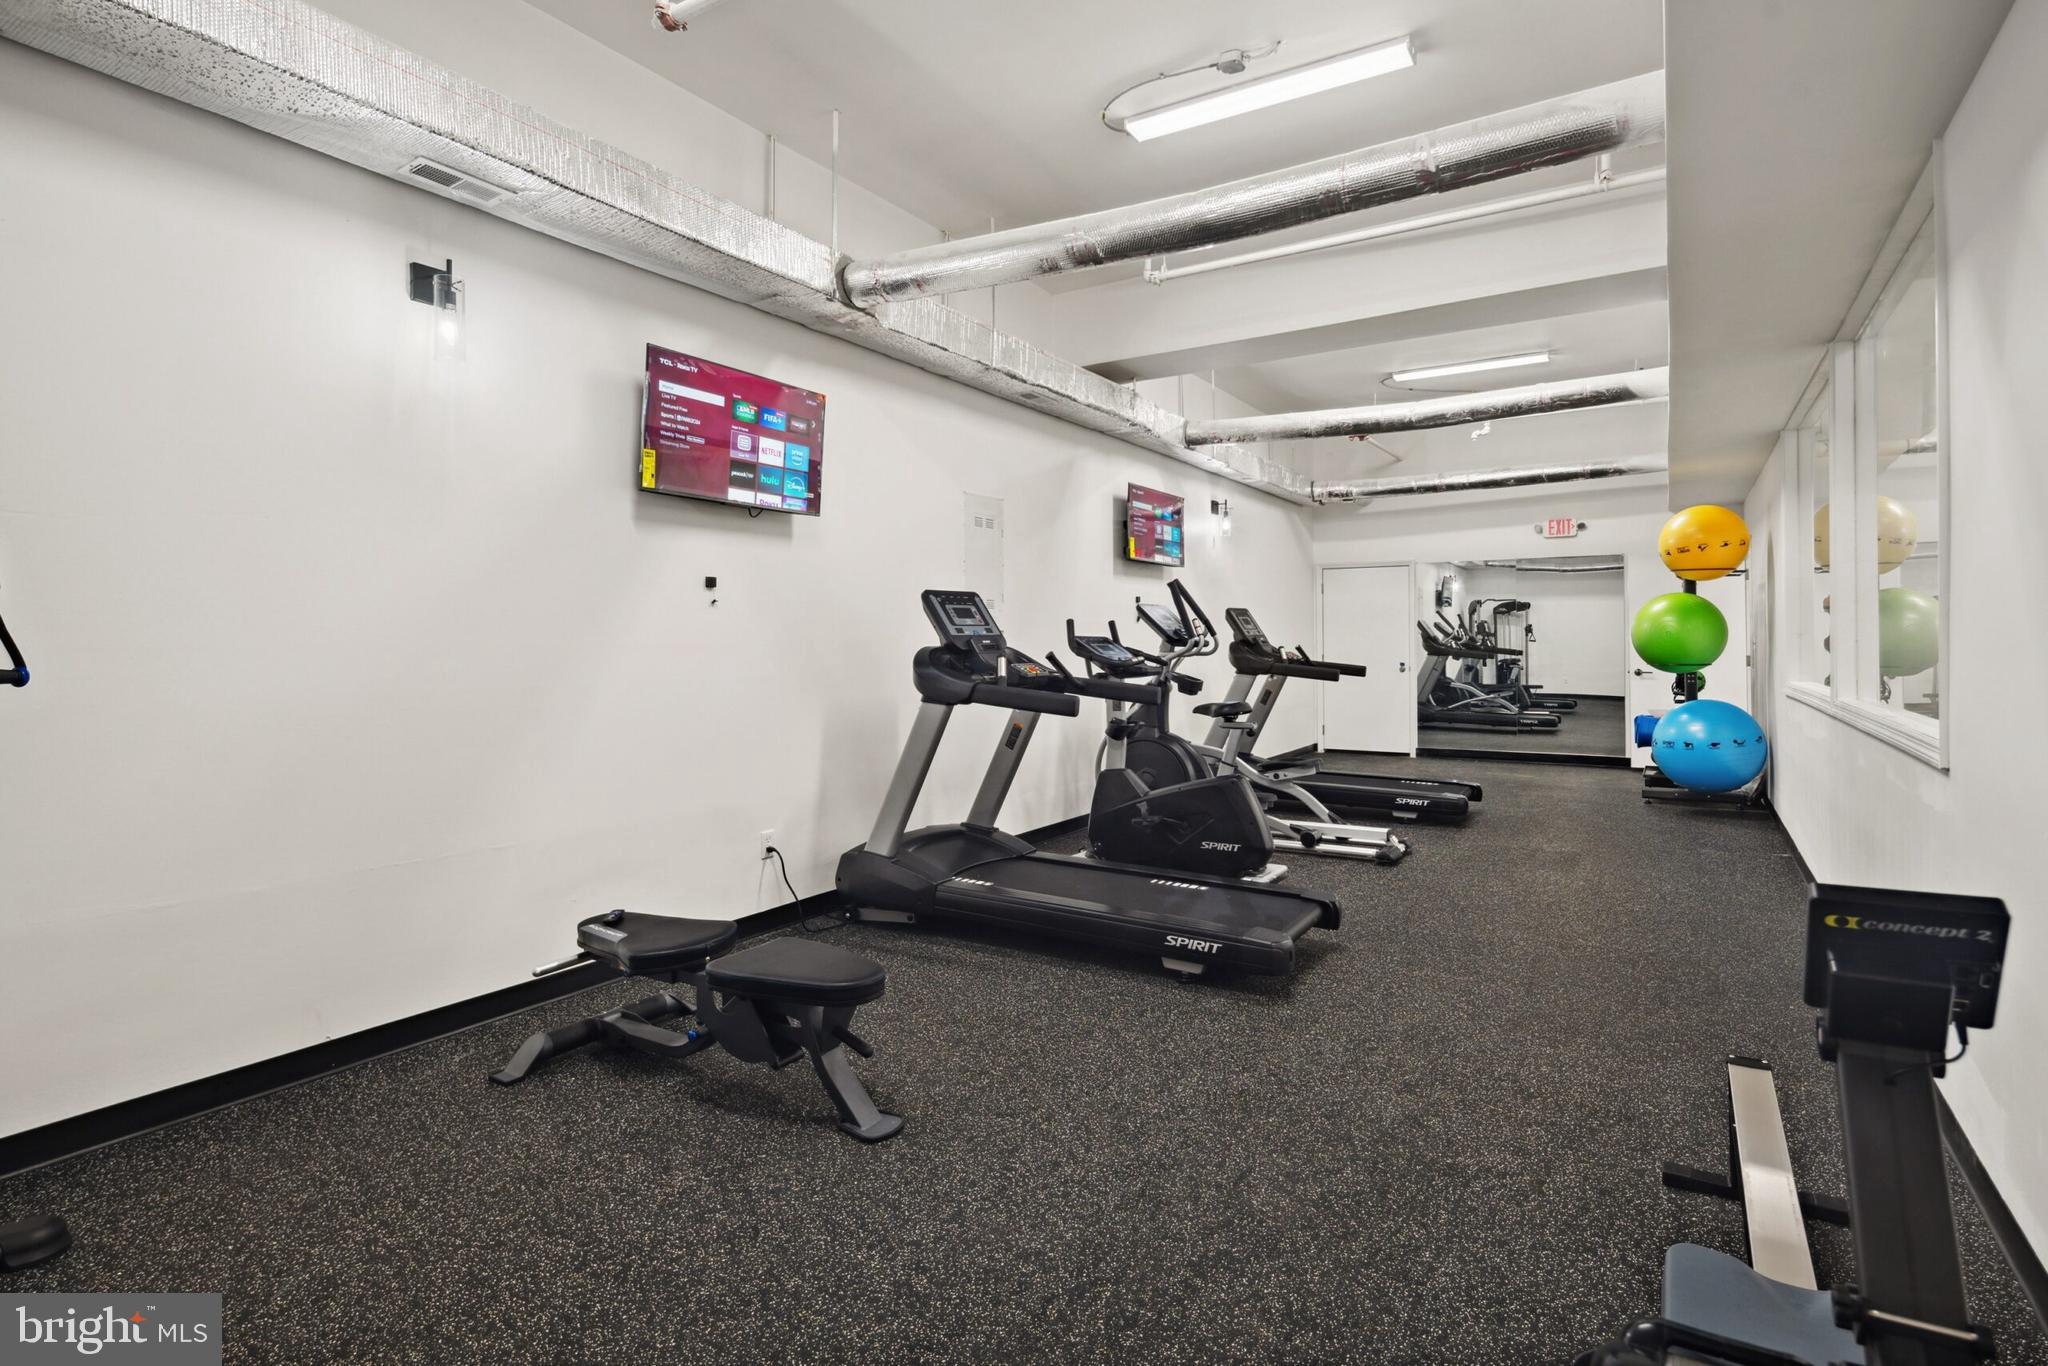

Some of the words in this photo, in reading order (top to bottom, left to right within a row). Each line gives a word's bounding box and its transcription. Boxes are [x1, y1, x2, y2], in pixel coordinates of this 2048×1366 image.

[659, 357, 673, 367] TCL
[691, 366, 699, 374] TV
[761, 447, 782, 458] NETFLIX
[760, 474, 780, 485] hulu
[1548, 519, 1572, 536] EXIT
[1395, 797, 1431, 807] SPIRIT
[1200, 841, 1242, 852] SPIRIT
[1862, 919, 1970, 939] concept
[1975, 929, 1993, 941] 2
[1164, 935, 1223, 954] SPIRIT
